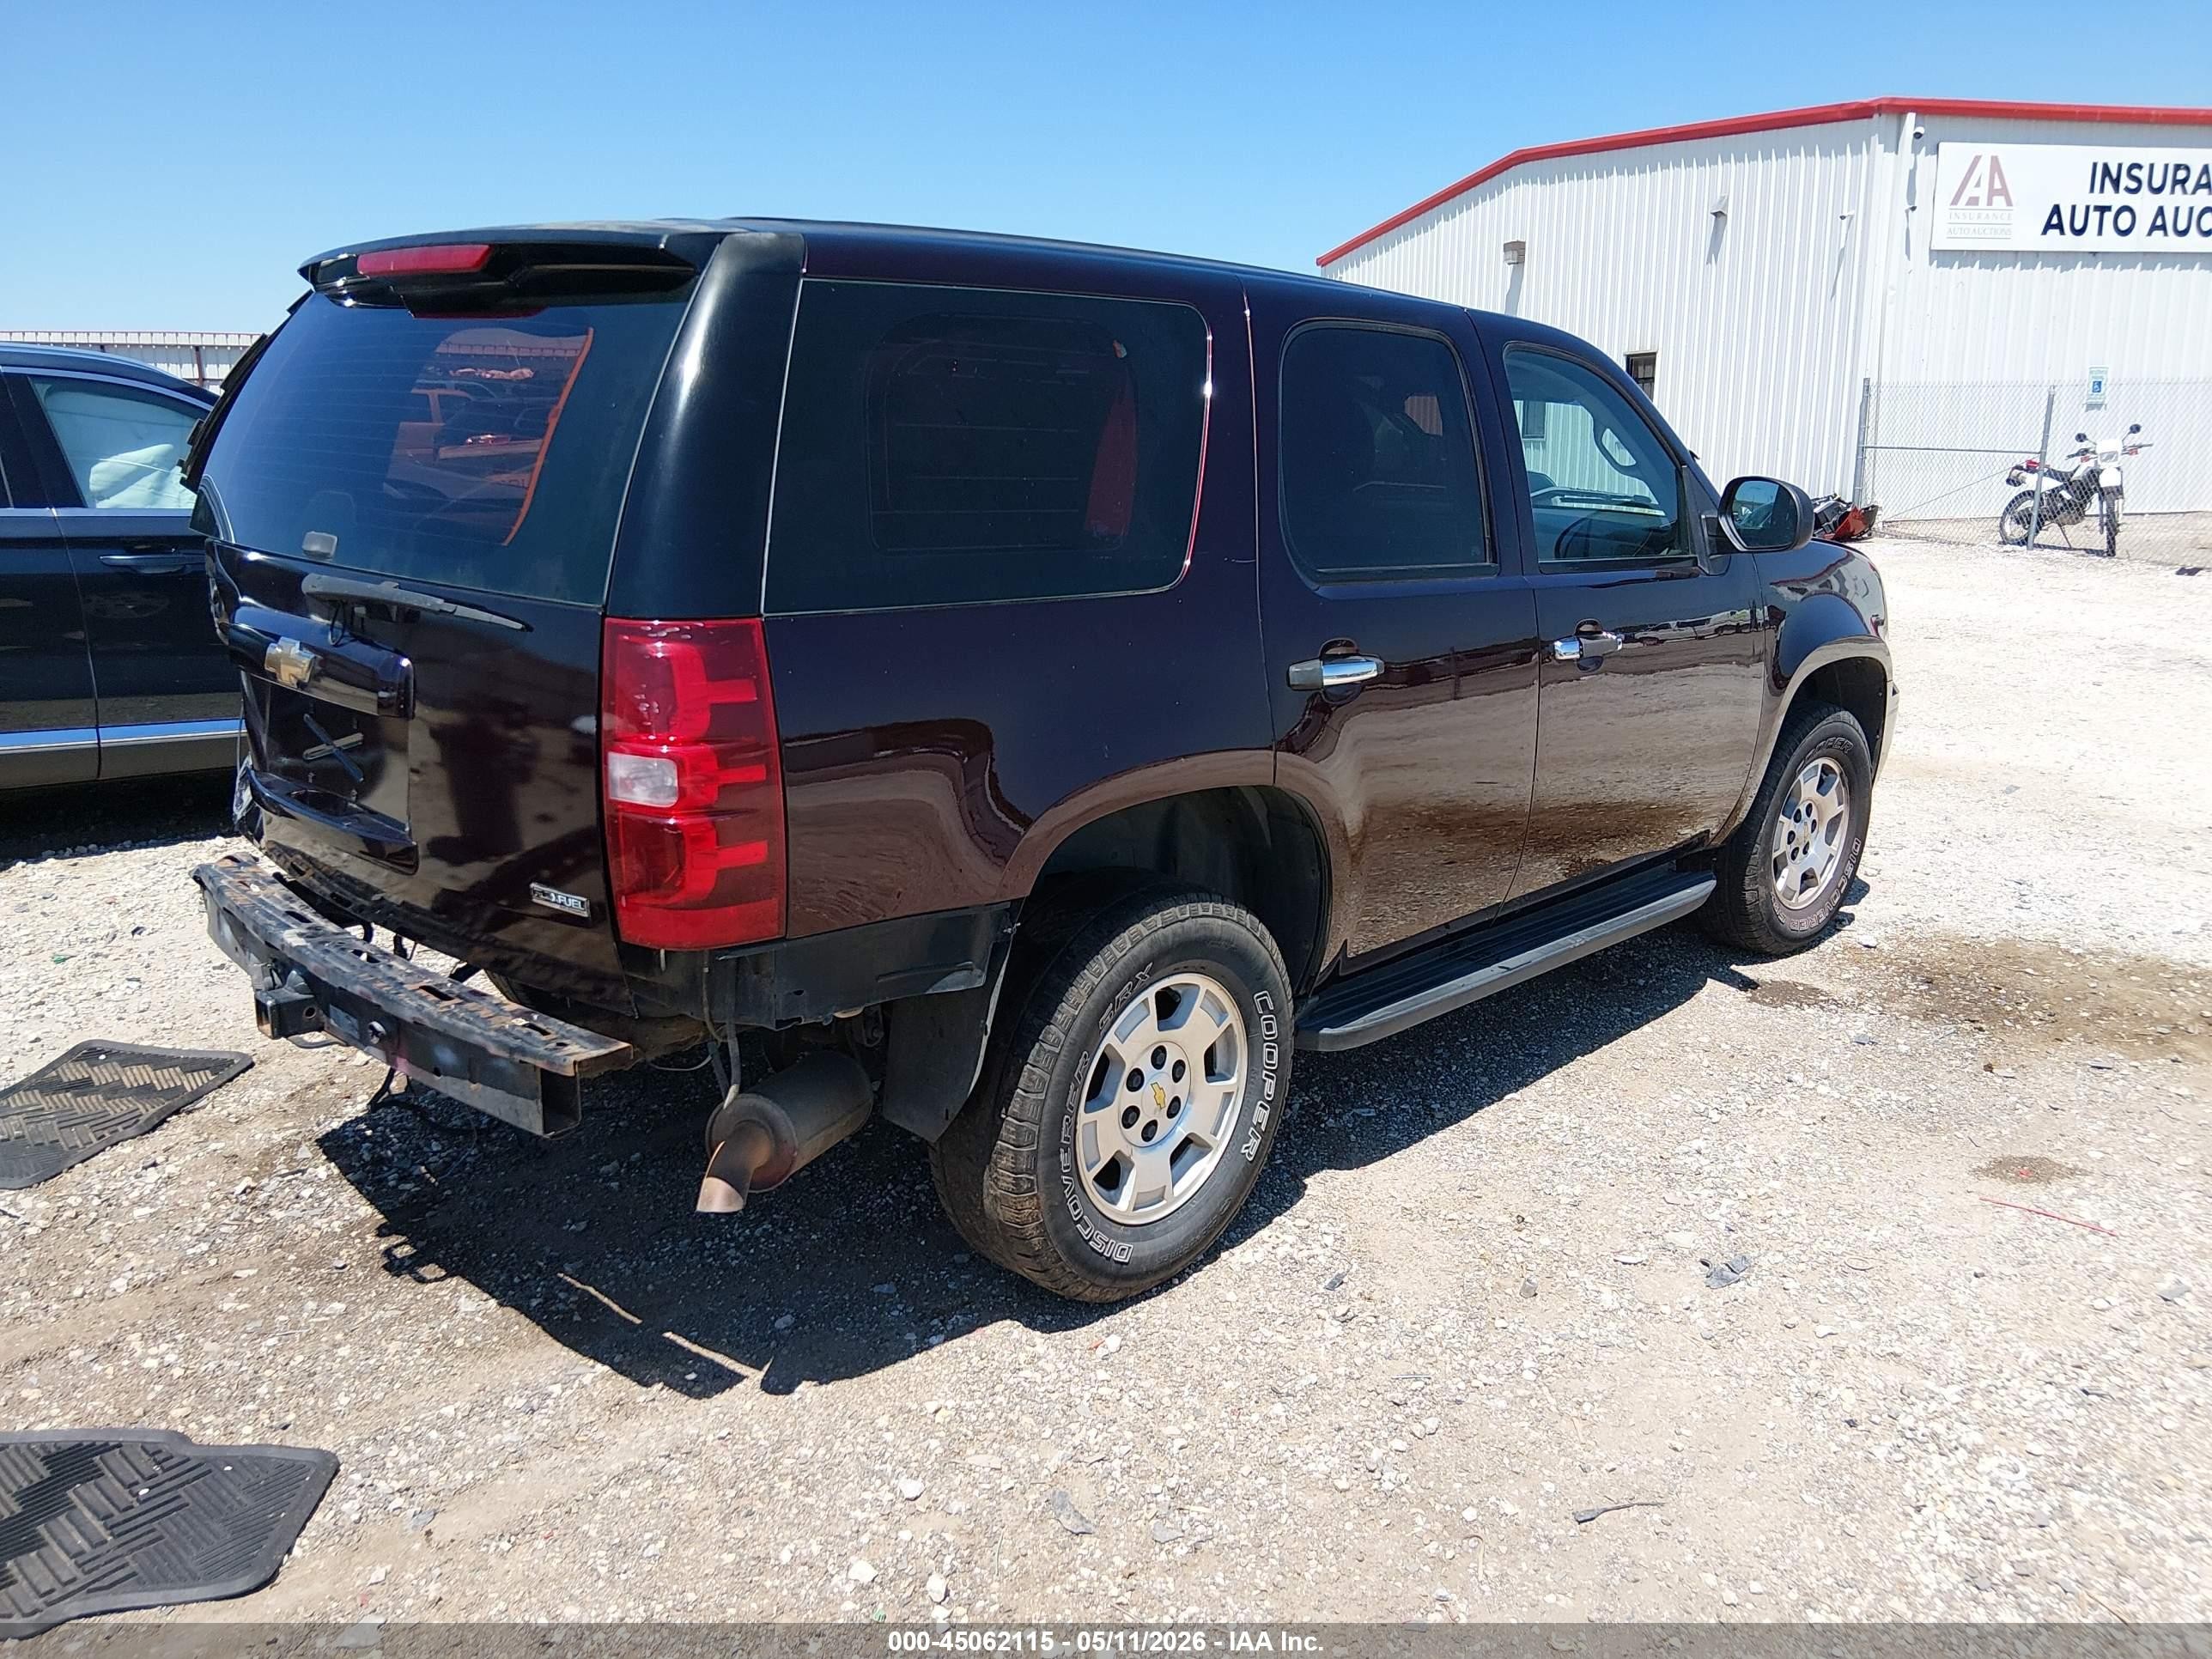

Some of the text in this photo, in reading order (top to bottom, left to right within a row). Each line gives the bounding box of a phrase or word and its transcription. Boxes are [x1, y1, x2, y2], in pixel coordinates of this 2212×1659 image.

[2088, 161, 2212, 195] INSURA
[1947, 226, 1971, 236] AUTO
[1948, 212, 2013, 221] INSURANCE
[2040, 204, 2212, 238] AUTO AUC
[1790, 837, 1862, 931] DISCOVERER
[1241, 990, 1279, 1162] COOPER
[1059, 1050, 1133, 1264] DISCOVERER
